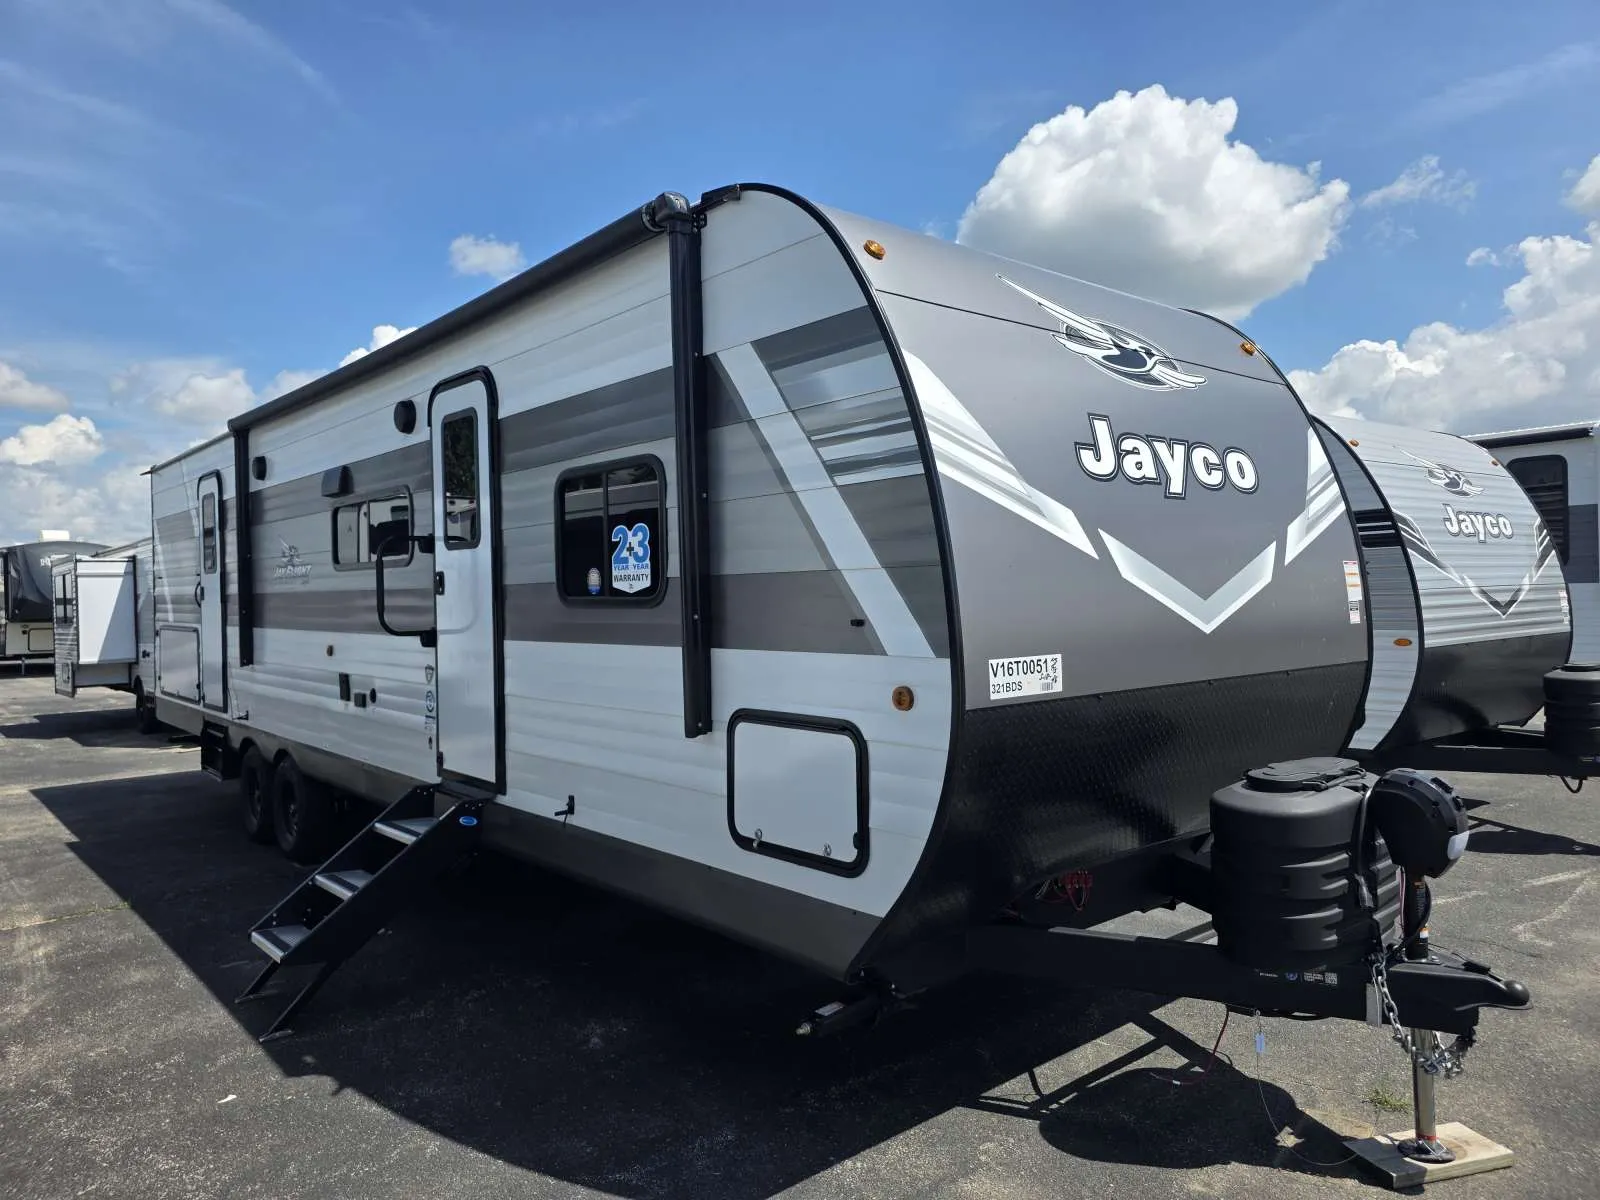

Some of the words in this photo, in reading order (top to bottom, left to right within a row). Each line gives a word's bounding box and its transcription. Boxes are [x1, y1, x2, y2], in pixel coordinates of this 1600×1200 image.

[1074, 412, 1259, 500] Jayco
[1442, 503, 1513, 543] Jayco
[613, 573, 649, 582] WARRANTY
[990, 658, 1048, 678] V16T0051
[991, 681, 1023, 694] 321BDS
